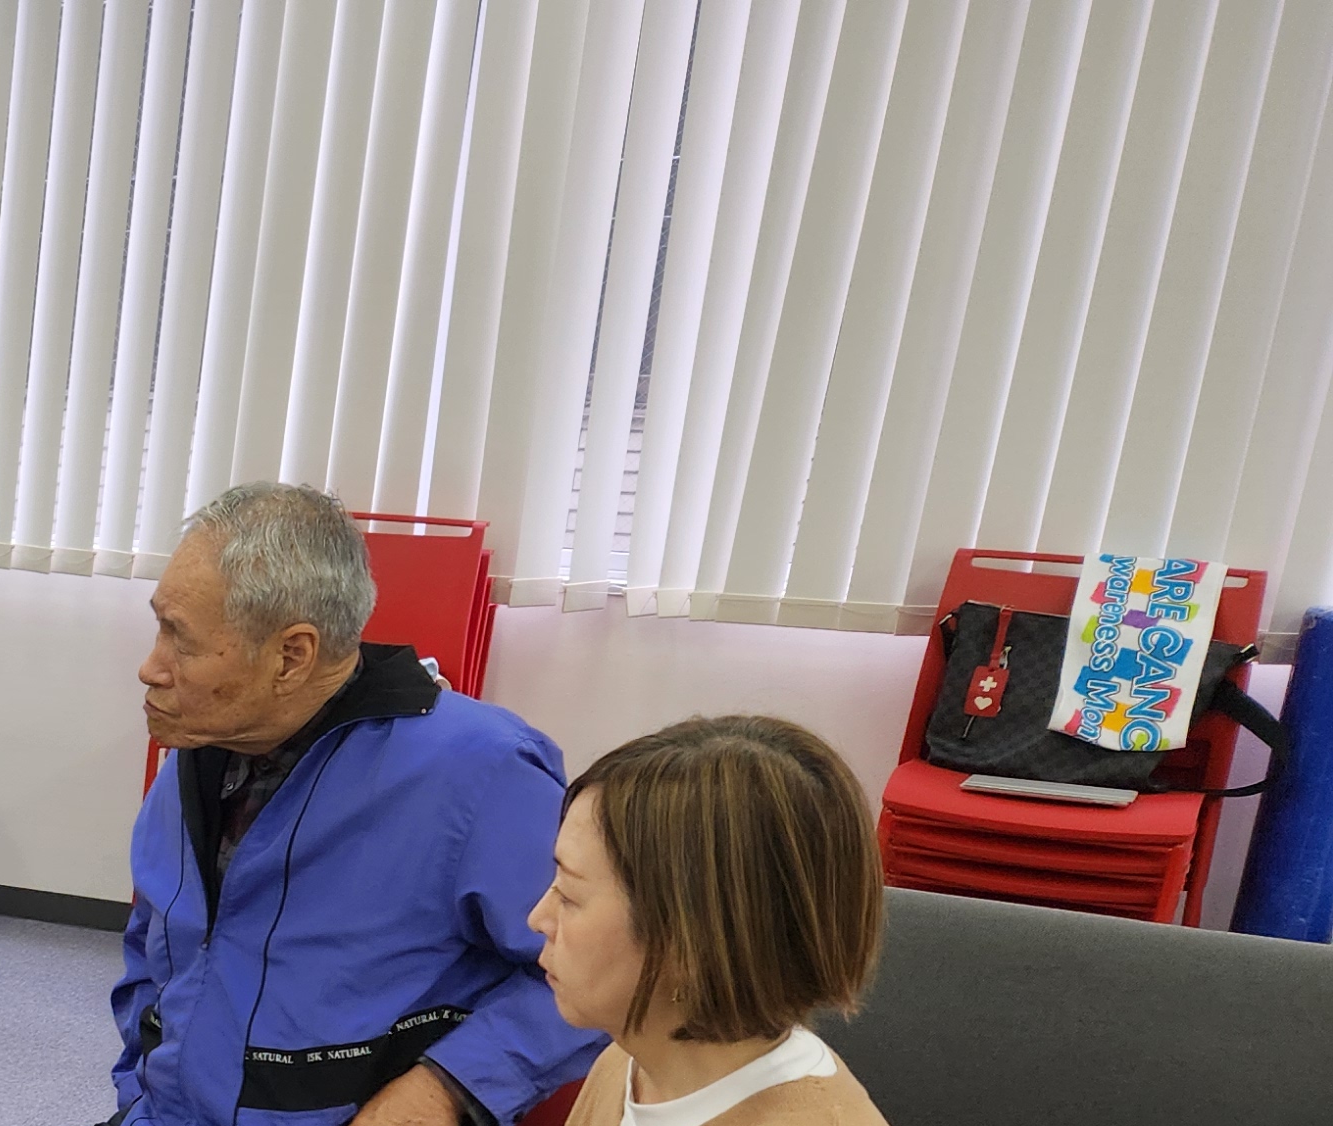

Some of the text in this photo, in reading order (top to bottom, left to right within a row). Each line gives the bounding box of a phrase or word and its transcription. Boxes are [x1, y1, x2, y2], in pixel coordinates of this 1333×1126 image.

[1119, 558, 1198, 753] ARE CANC
[1077, 679, 1121, 743] Mon
[395, 1011, 440, 1032] NATURAL
[327, 1045, 373, 1060] NATURAL
